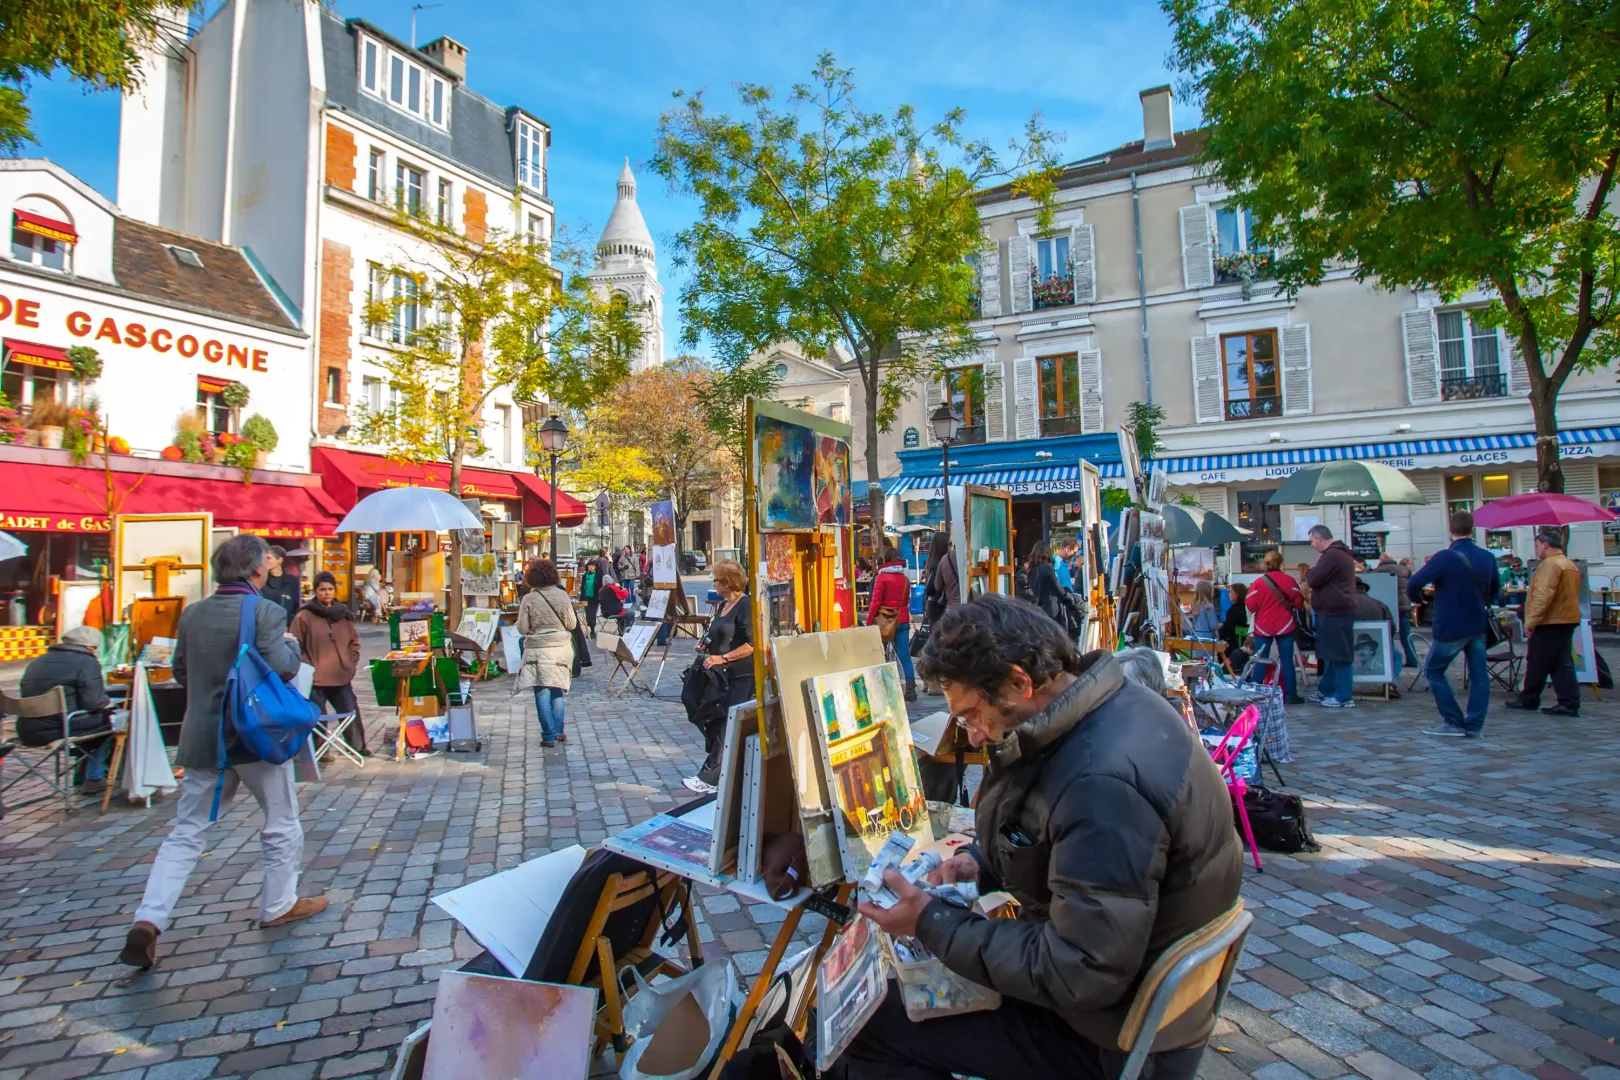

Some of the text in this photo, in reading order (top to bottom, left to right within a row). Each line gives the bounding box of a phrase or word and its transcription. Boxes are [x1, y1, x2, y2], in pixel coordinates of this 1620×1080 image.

[66, 310, 269, 373] GASCOGNE
[1558, 446, 1593, 455] PIZZA
[1460, 451, 1508, 463] GLACES
[1200, 472, 1226, 481] CAFE
[1007, 483, 1029, 493] DES
[1035, 477, 1104, 492] CHASSES
[56, 519, 76, 530] de
[850, 744, 868, 756] PAUL
